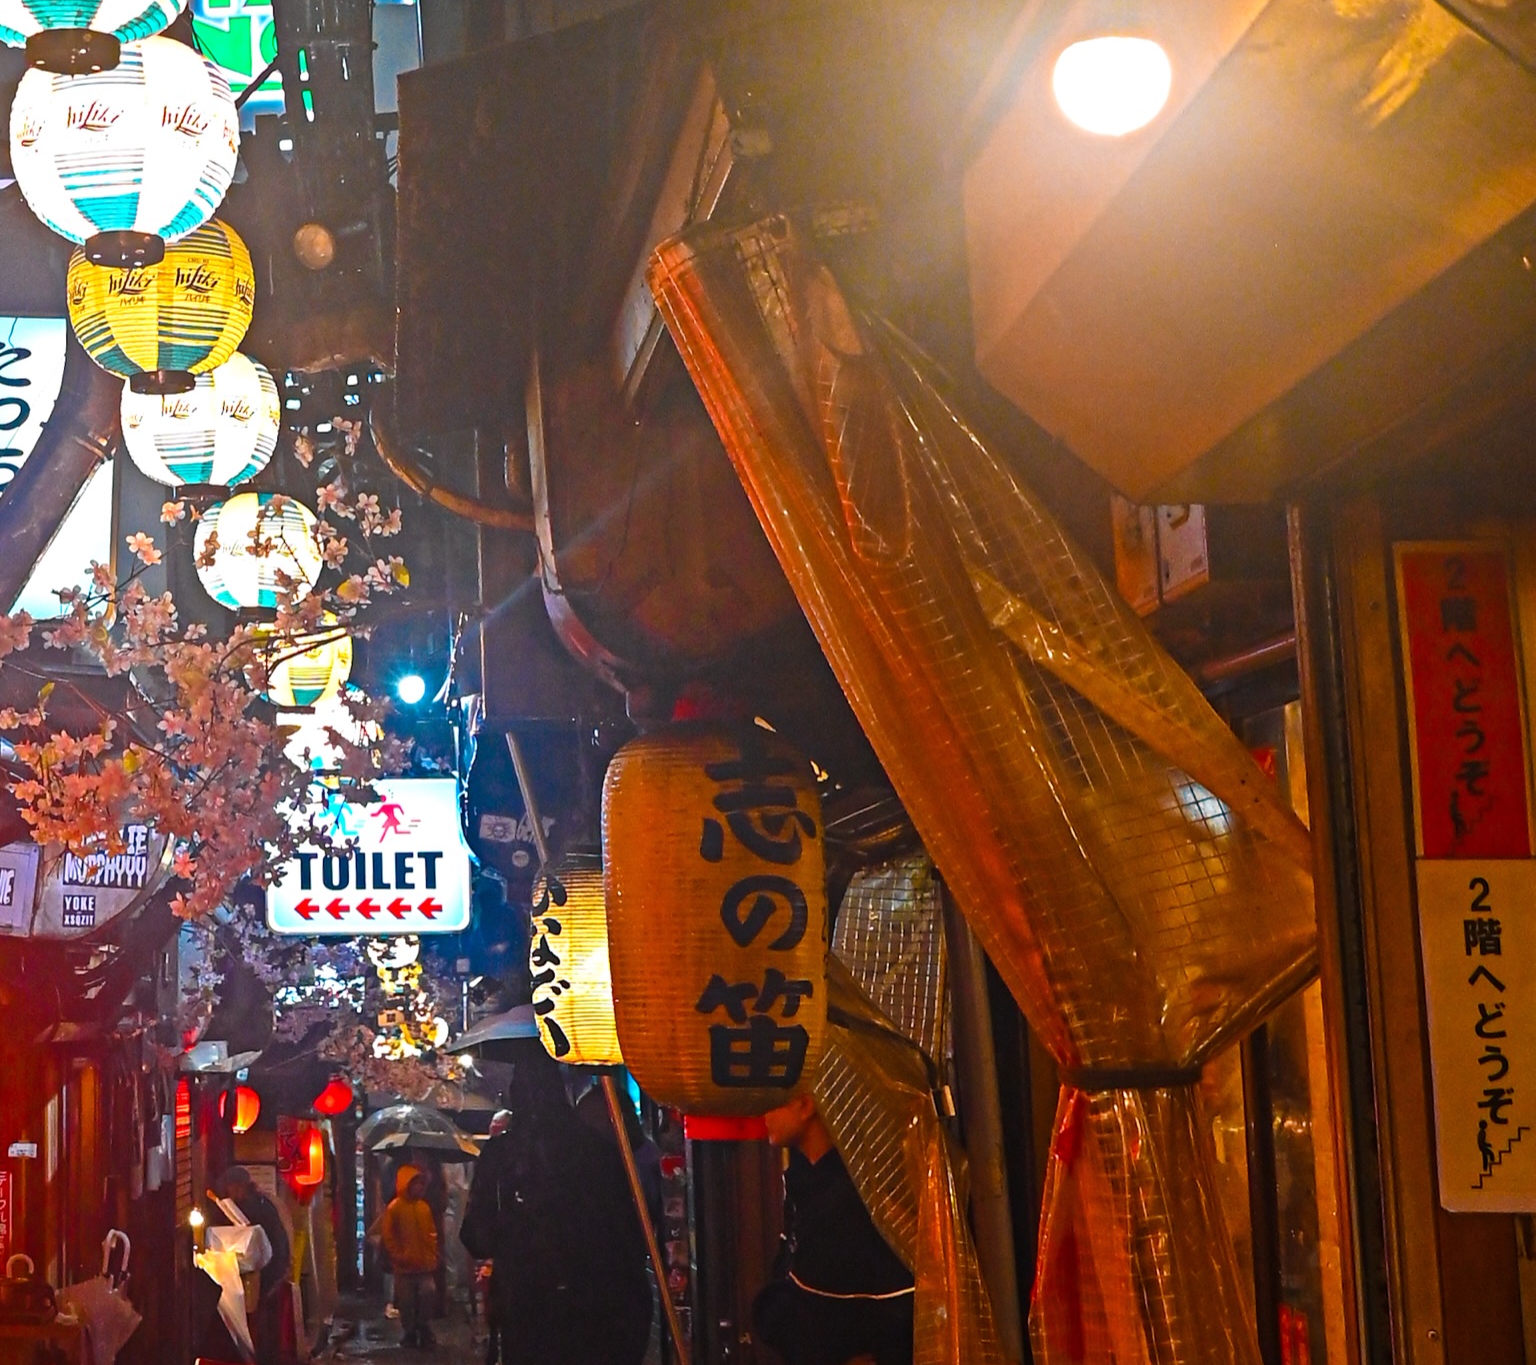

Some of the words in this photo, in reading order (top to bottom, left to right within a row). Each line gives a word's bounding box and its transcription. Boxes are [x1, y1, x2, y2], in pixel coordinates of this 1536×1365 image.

[294, 851, 443, 891] TOILET
[65, 896, 95, 911] YOKE
[1463, 877, 1514, 1126] 2階へどうぞ
